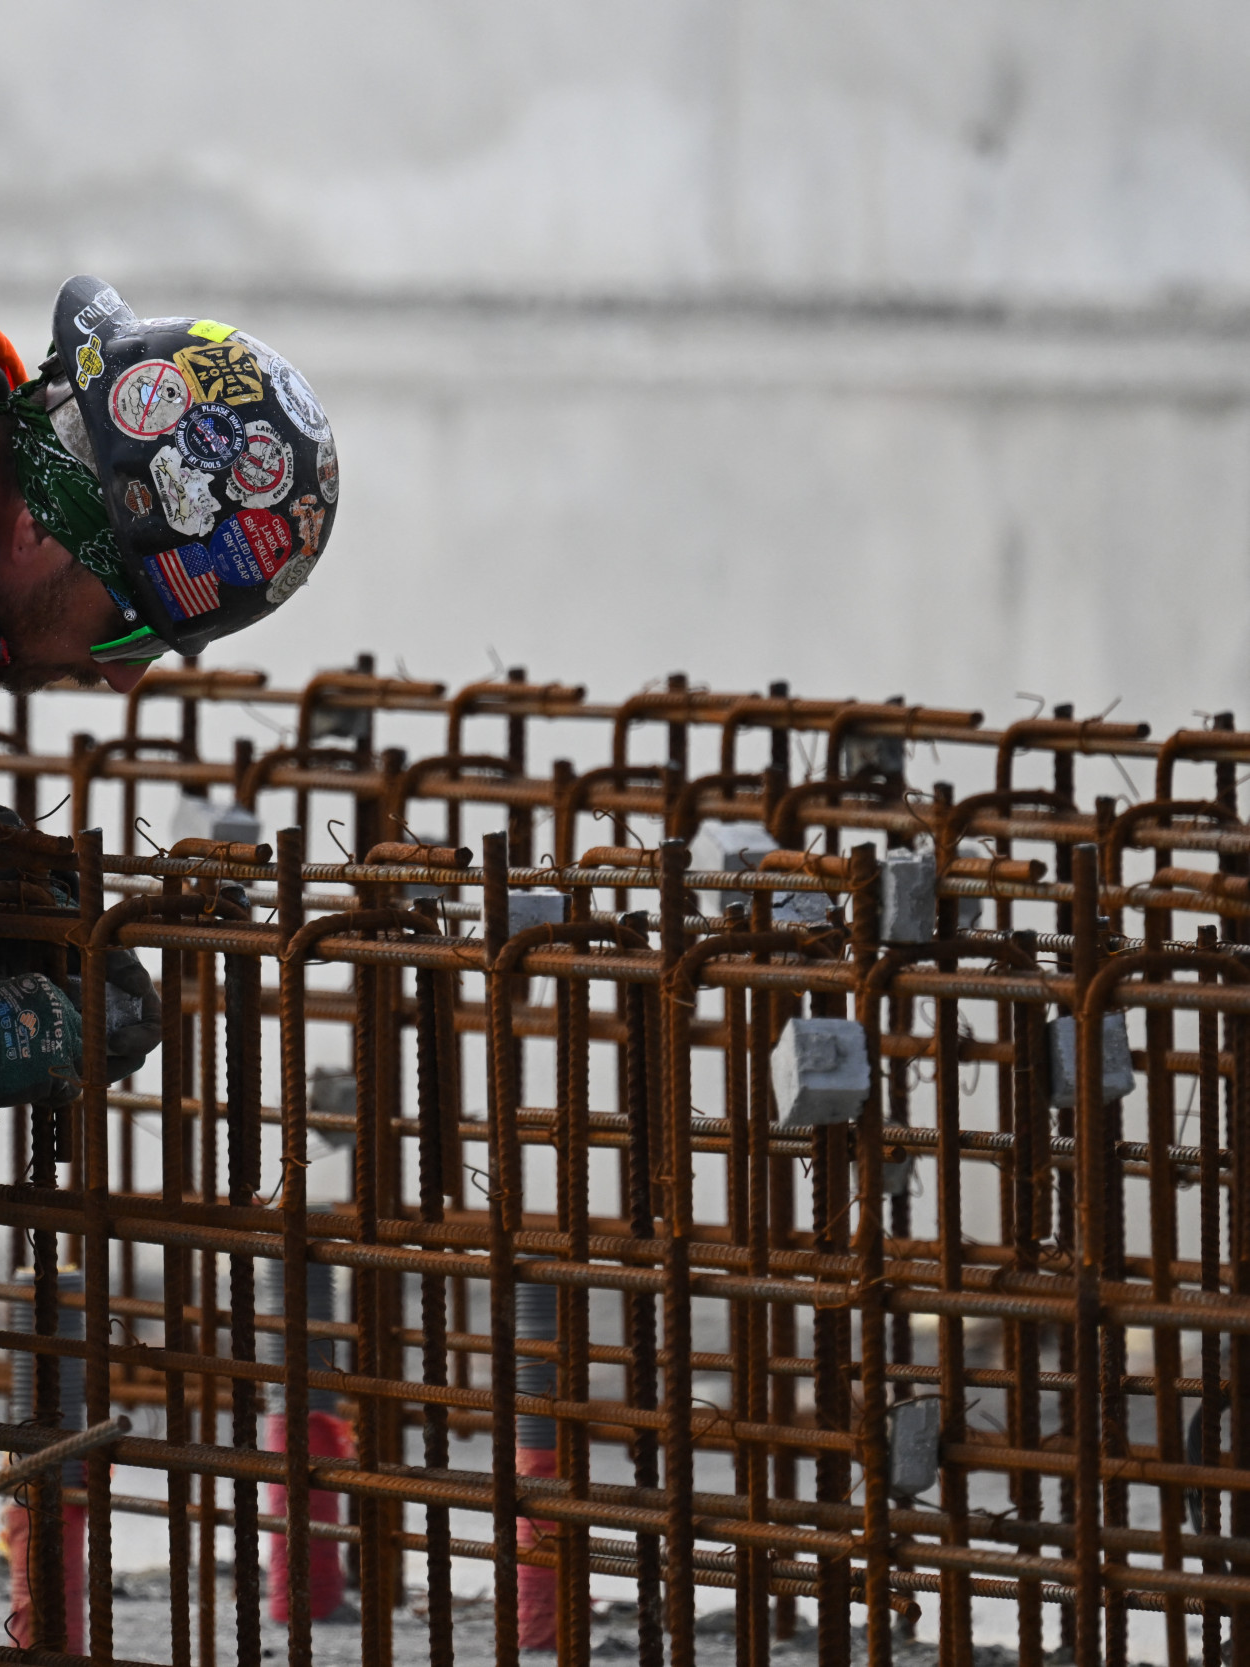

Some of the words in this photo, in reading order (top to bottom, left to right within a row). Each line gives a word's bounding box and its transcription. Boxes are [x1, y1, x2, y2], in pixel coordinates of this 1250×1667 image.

[197, 361, 253, 381] UNION
[201, 405, 230, 417] PLEASE
[178, 419, 188, 429] TO
[229, 414, 243, 435] DON'T
[177, 430, 190, 456] BORROW
[233, 437, 243, 451] ASK
[187, 455, 201, 465] MY
[200, 461, 222, 469] TOOLS
[285, 451, 293, 480] LOCAL
[272, 518, 290, 547] CHEAP
[229, 519, 251, 555] SKILLED
[245, 555, 263, 581] LABOR
[243, 515, 260, 539] ISN'T
[254, 539, 275, 573] SKILLED
[222, 531, 239, 553] ISN'T
[232, 554, 250, 580] CHEAP
